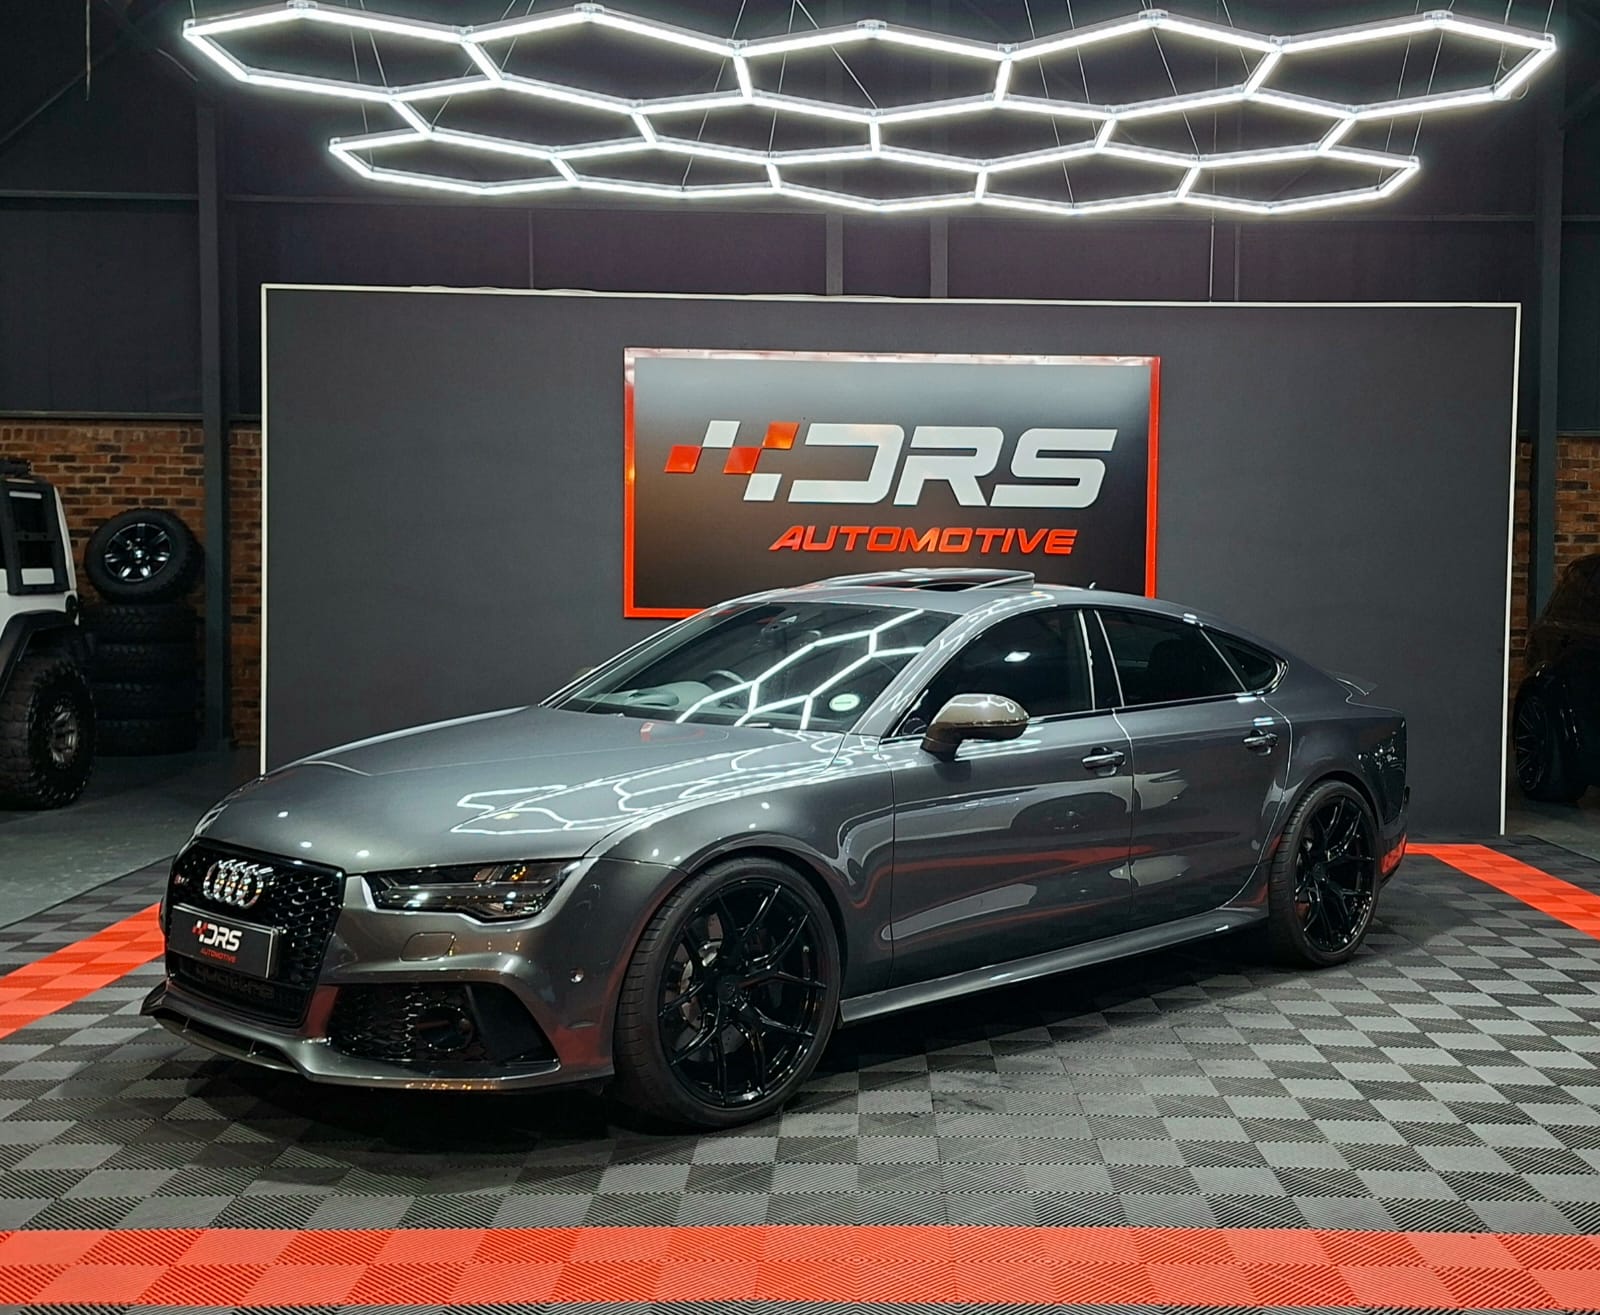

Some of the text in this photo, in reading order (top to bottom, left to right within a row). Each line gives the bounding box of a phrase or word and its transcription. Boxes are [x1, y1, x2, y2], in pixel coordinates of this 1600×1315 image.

[788, 423, 1118, 508] DRS
[769, 525, 1078, 554] AUTOMOTIVE
[203, 923, 242, 951] DRS
[200, 948, 237, 963] AUTOMOTIVE
